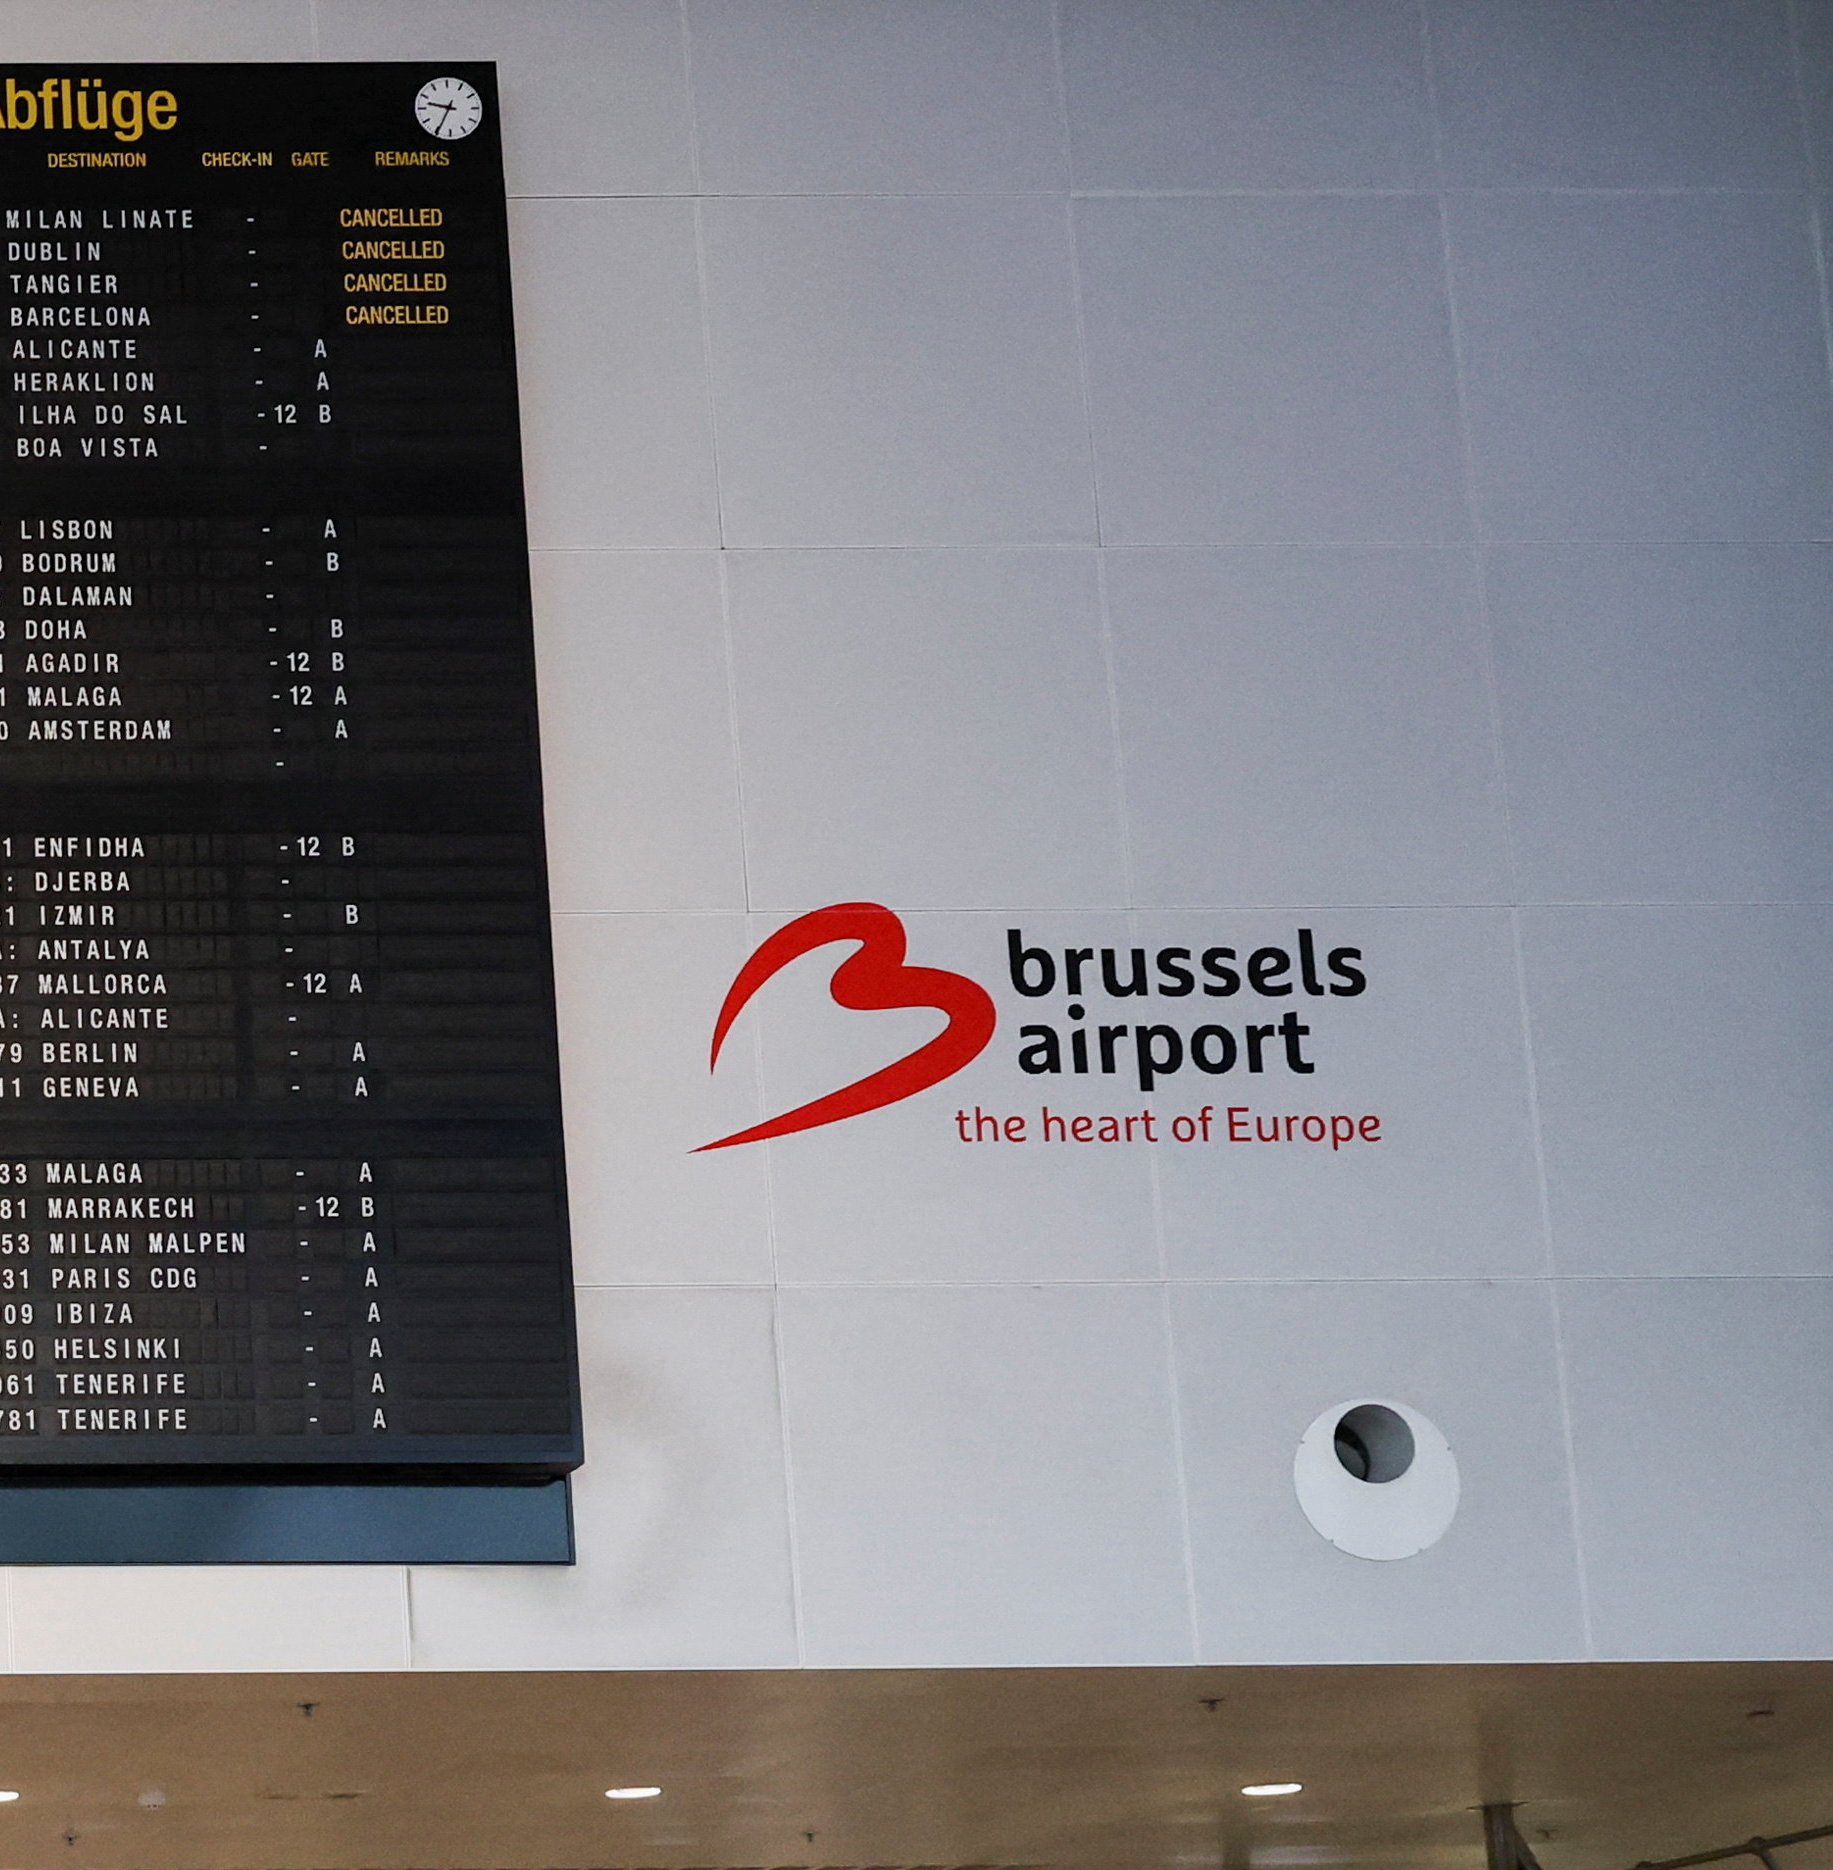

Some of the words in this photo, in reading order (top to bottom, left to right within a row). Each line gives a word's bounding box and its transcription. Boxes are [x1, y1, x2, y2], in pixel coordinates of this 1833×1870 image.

[47, 152, 146, 168] DESTINATION
[202, 151, 272, 167] CHECK-IN
[291, 154, 329, 168] GATE
[375, 153, 449, 168] REMARKS
[8, 242, 100, 261] DUBLIN
[342, 240, 445, 260] CANCELLED
[22, 552, 116, 573] BODRUM
[326, 552, 339, 572] B
[40, 905, 114, 926] IZMIR
[1007, 928, 1367, 998] brussels
[1018, 1003, 1315, 1092] airport
[955, 1106, 1027, 1143] the
[1042, 1106, 1158, 1143] heart
[1171, 1105, 1214, 1143] of
[1227, 1106, 1383, 1151] Europe
[49, 1232, 130, 1254] MILAN
[148, 1232, 245, 1254] MALPEN
